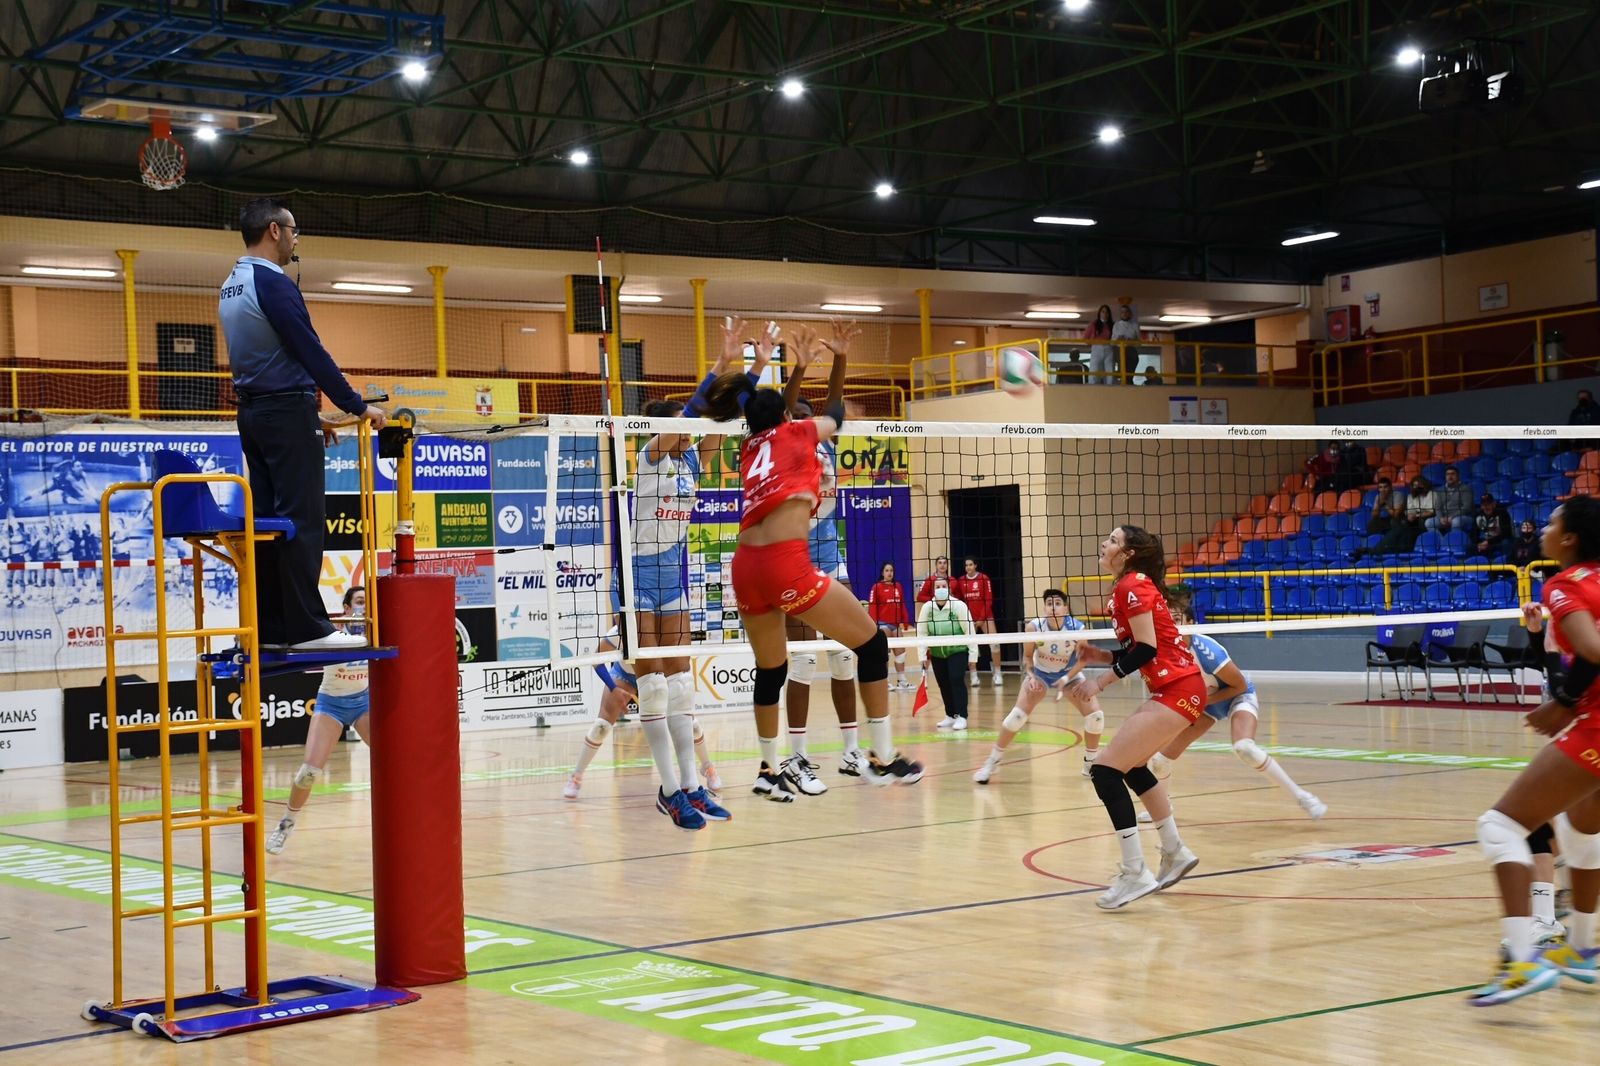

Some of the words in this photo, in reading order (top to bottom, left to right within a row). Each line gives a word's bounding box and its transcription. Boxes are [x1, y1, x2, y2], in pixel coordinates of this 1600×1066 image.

[221, 284, 243, 300] RFEVB
[595, 418, 650, 429] rfe.com
[876, 423, 923, 433] rfevb.com
[1001, 425, 1045, 435] rfevb.com
[1118, 427, 1159, 435] rfevb.com
[1228, 428, 1267, 436] rfevb.com
[1331, 428, 1368, 436] rfevb.com
[1429, 428, 1465, 436] rfevb.com
[1523, 428, 1557, 436] rfevb.com
[1, 441, 17, 452] EL
[22, 441, 73, 453] MOTOR
[78, 441, 96, 453] DE
[100, 441, 164, 453] NUESTRO
[415, 445, 485, 462] JUVASA
[497, 459, 540, 468] Fundación
[557, 456, 595, 472] Cajasol
[746, 440, 775, 481] 4
[415, 465, 487, 477] PACKAGING
[441, 503, 487, 517] ANDEVALO
[695, 498, 738, 516] Cajasol
[850, 495, 892, 512] Cajasol
[531, 505, 600, 523] JVASA
[656, 506, 692, 520] arena
[522, 573, 603, 590] MILGRITO”
[0, 628, 52, 641] JUVASA
[67, 624, 124, 640] avana
[67, 640, 105, 648] PACKAGI
[1050, 643, 1058, 654] 8
[231, 694, 316, 727] Cajaso
[598, 983, 918, 1052] AYTO.
